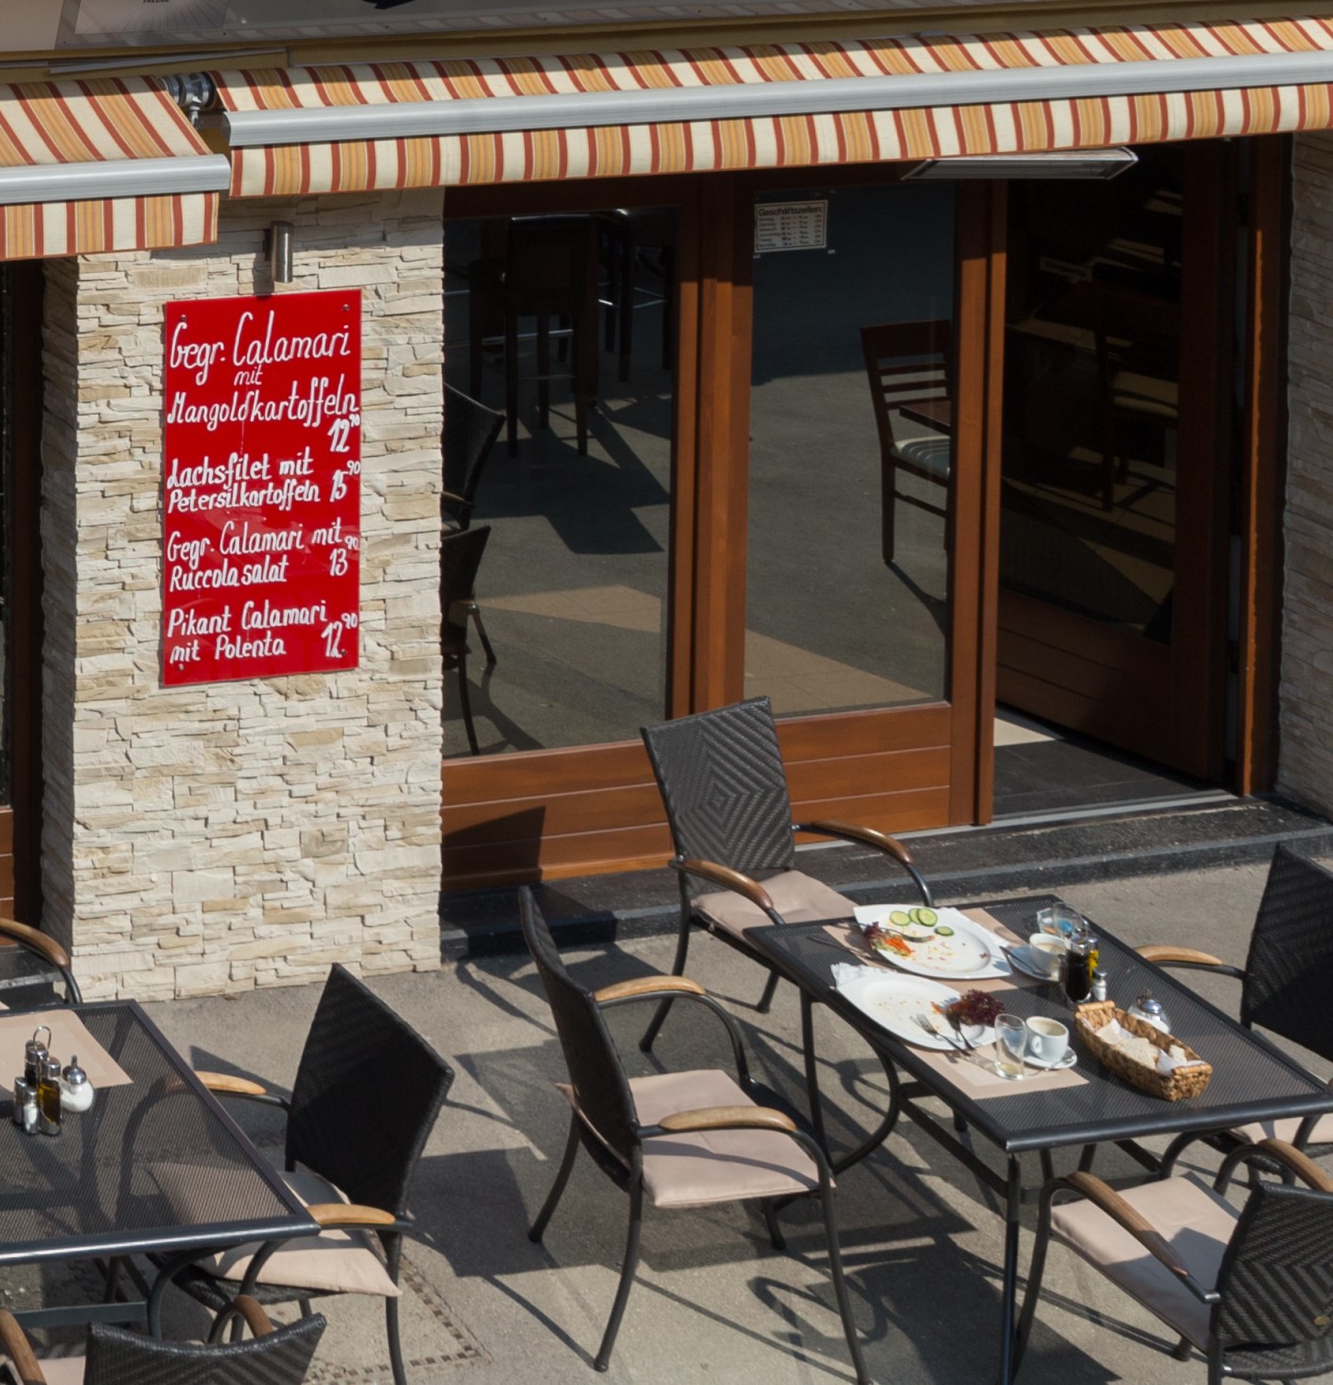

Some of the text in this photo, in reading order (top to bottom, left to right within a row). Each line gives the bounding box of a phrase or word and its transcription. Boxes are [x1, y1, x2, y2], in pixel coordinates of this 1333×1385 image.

[169, 310, 351, 385] Gegr. Calamari
[233, 364, 264, 387] mit
[166, 373, 360, 432] Mangoldkartoffeln
[166, 446, 315, 491] Lachsfilet mit
[167, 480, 321, 514] Petersilkartoffeln
[167, 516, 343, 570] Gegr. Calamari mit
[167, 600, 328, 638] Pikant Calamari
[169, 639, 201, 664] mit
[214, 634, 287, 661] Polenta
